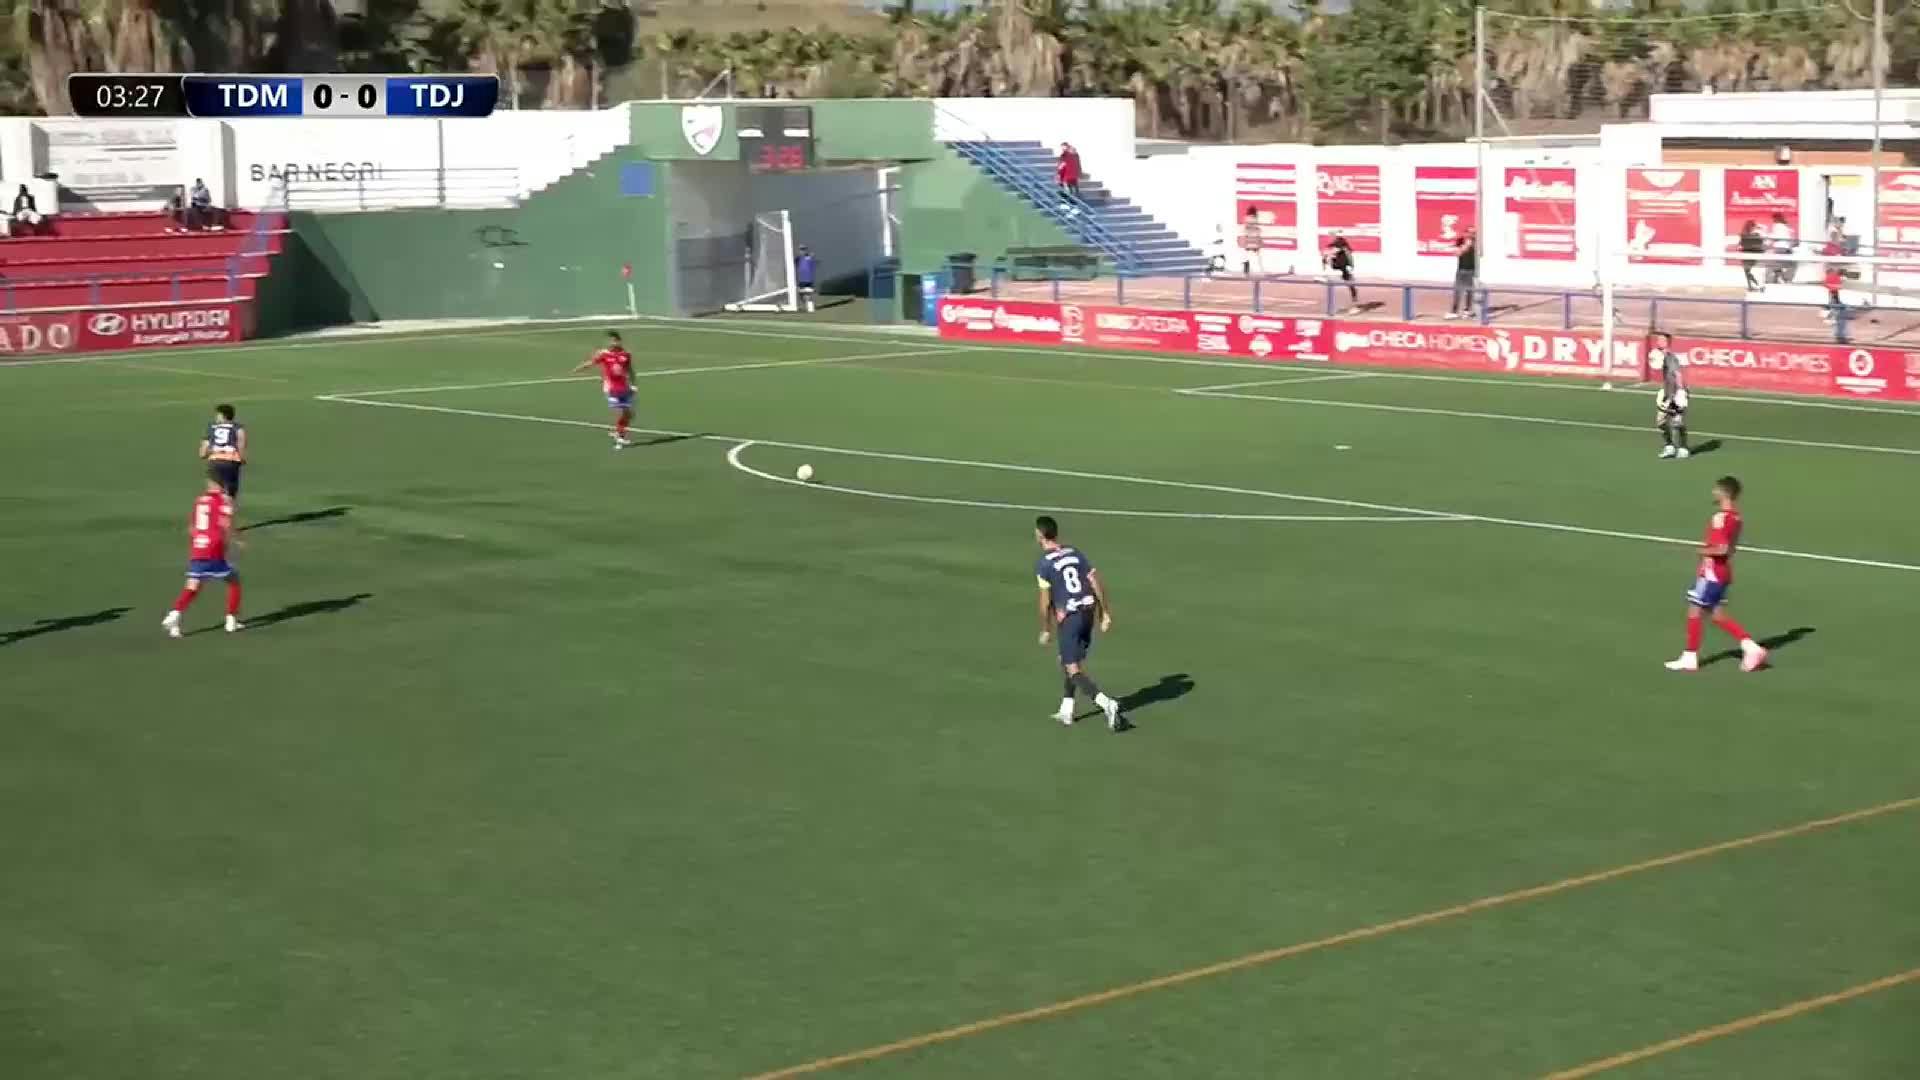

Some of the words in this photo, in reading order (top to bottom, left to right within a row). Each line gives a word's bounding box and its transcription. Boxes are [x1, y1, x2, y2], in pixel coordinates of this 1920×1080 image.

[250, 163, 299, 182] BAR
[131, 309, 230, 332] HYUNDAI
[0, 322, 72, 351] ADO
[1369, 329, 1425, 348] CHECA
[1428, 333, 1488, 353] HOMES
[1688, 346, 1757, 368] CHECA
[1760, 352, 1830, 375] HOMES
[213, 428, 230, 446] 9
[1062, 565, 1082, 593] 8
